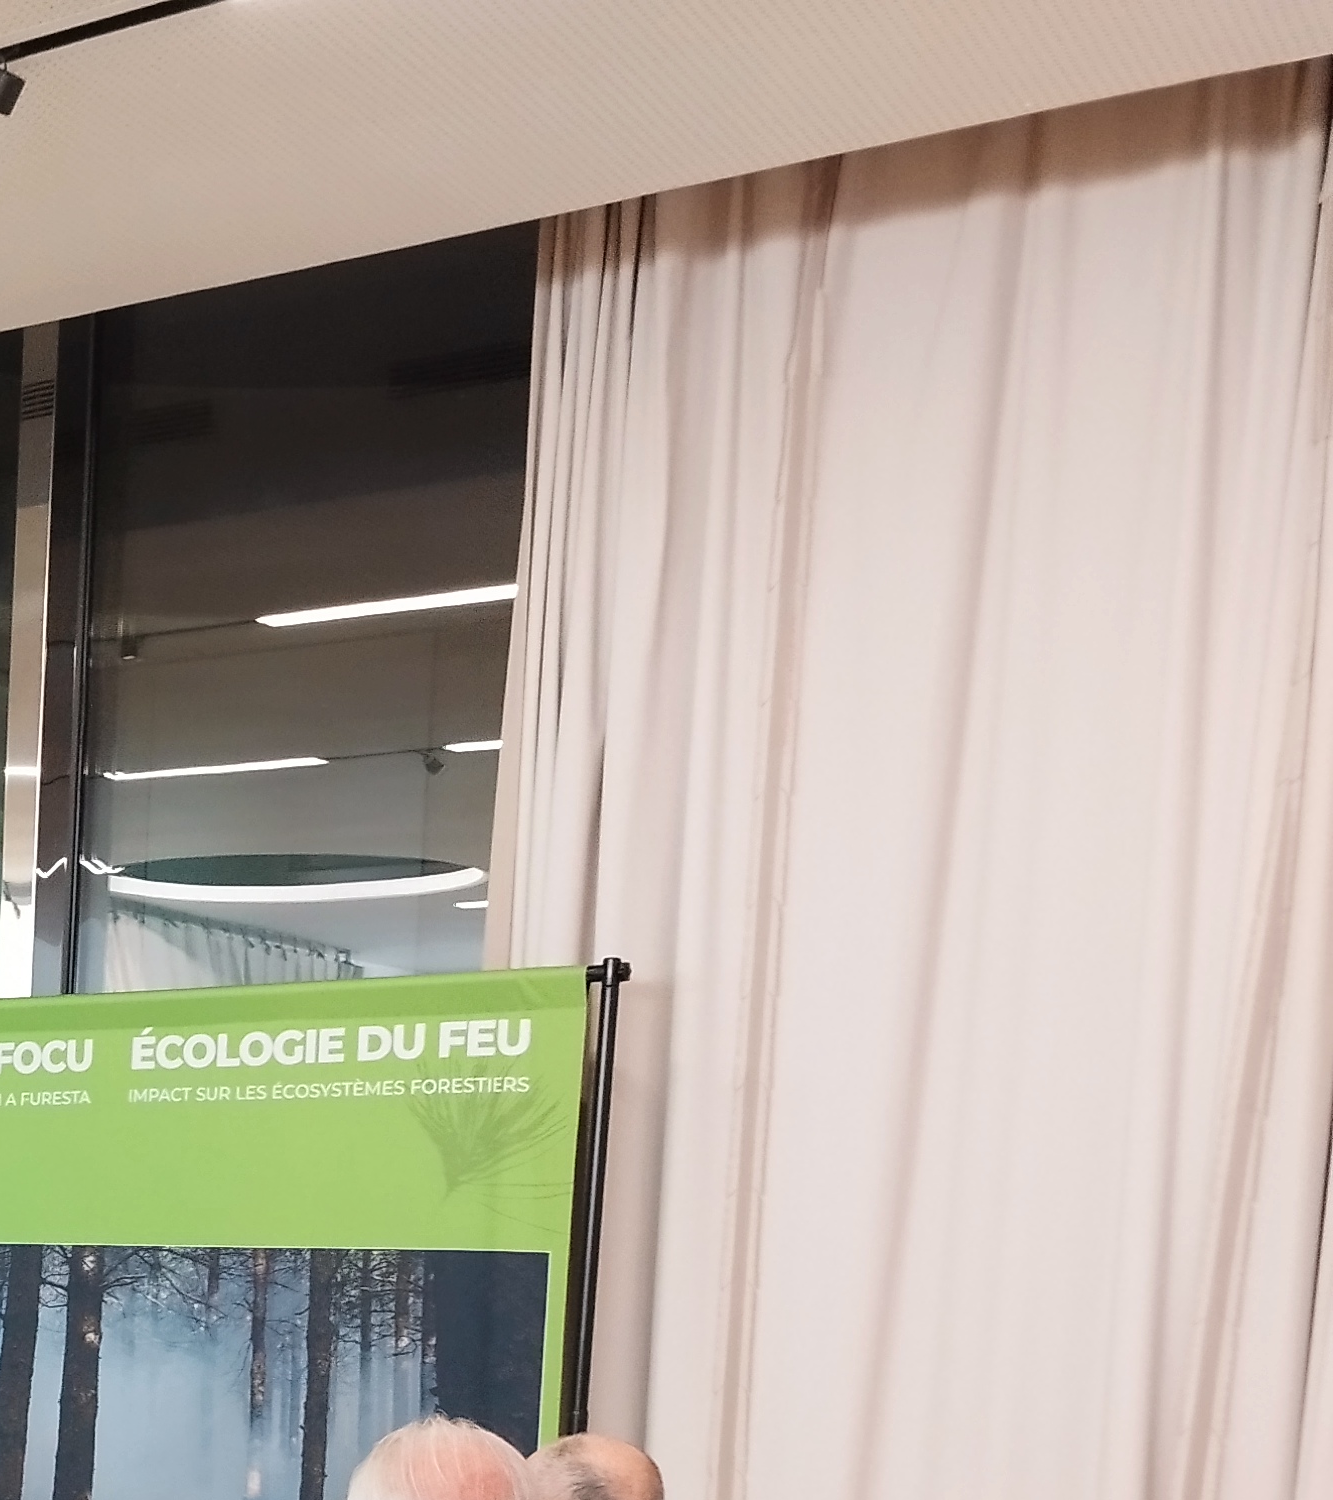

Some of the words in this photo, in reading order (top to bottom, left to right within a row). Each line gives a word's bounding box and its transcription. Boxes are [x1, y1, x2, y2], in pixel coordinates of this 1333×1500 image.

[130, 1027, 345, 1070] ÉCOLOGIE
[357, 1023, 427, 1062] DU
[438, 1019, 531, 1058] FEU
[5, 1093, 17, 1106] A
[21, 1090, 91, 1106] FURESTA
[128, 1087, 192, 1103] IMPACT
[196, 1086, 230, 1101] SUR
[236, 1084, 267, 1100] LES
[272, 1079, 405, 1099] ÉCOSYSTÈMES
[410, 1076, 530, 1095] FORESTIERS
